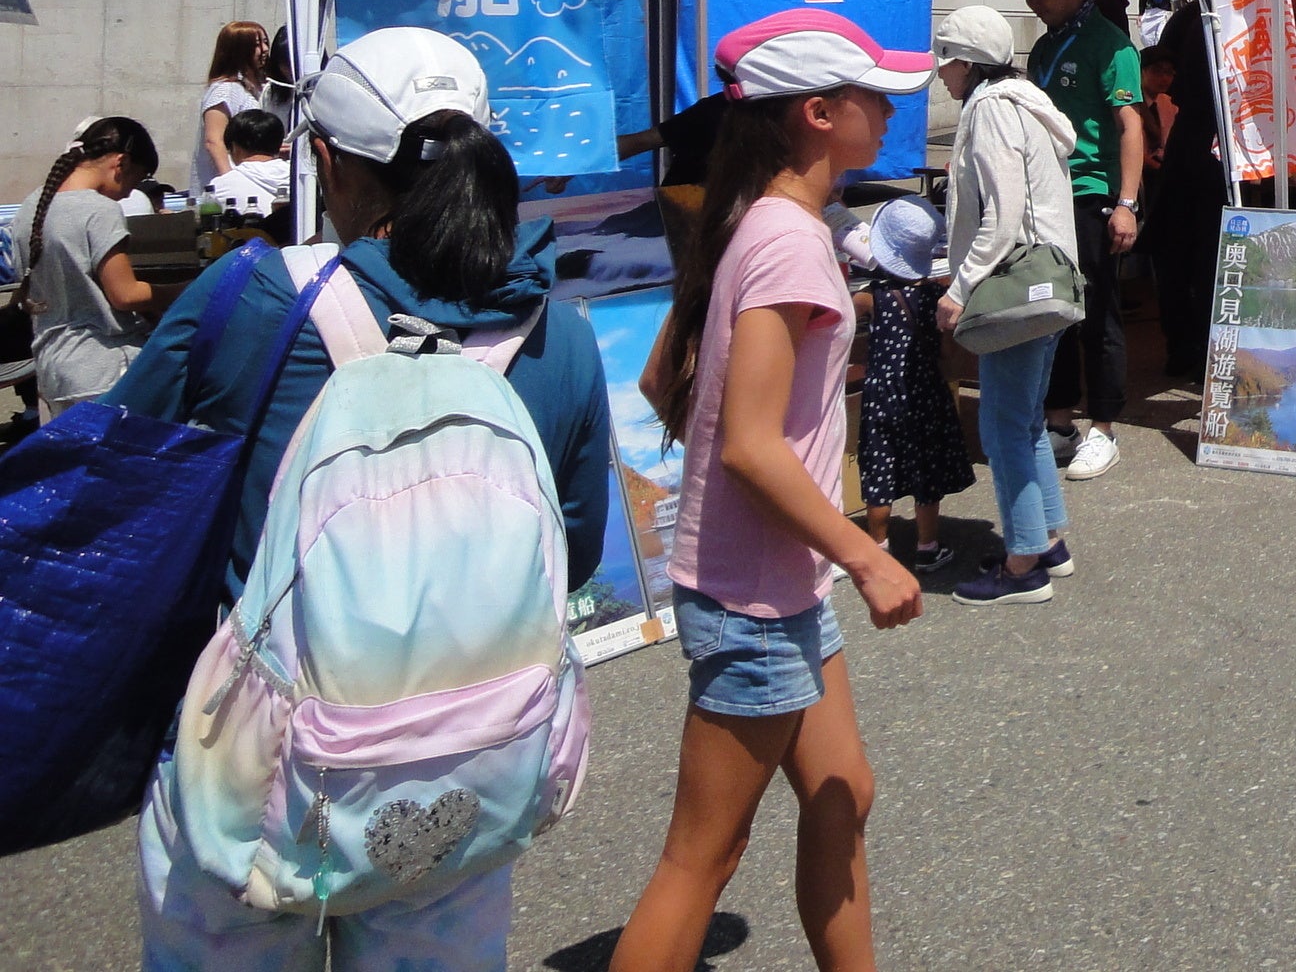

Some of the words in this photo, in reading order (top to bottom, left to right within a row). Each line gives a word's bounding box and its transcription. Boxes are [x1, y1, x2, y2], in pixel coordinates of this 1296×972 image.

[1204, 243, 1247, 438] 奥只見湖遊覧船
